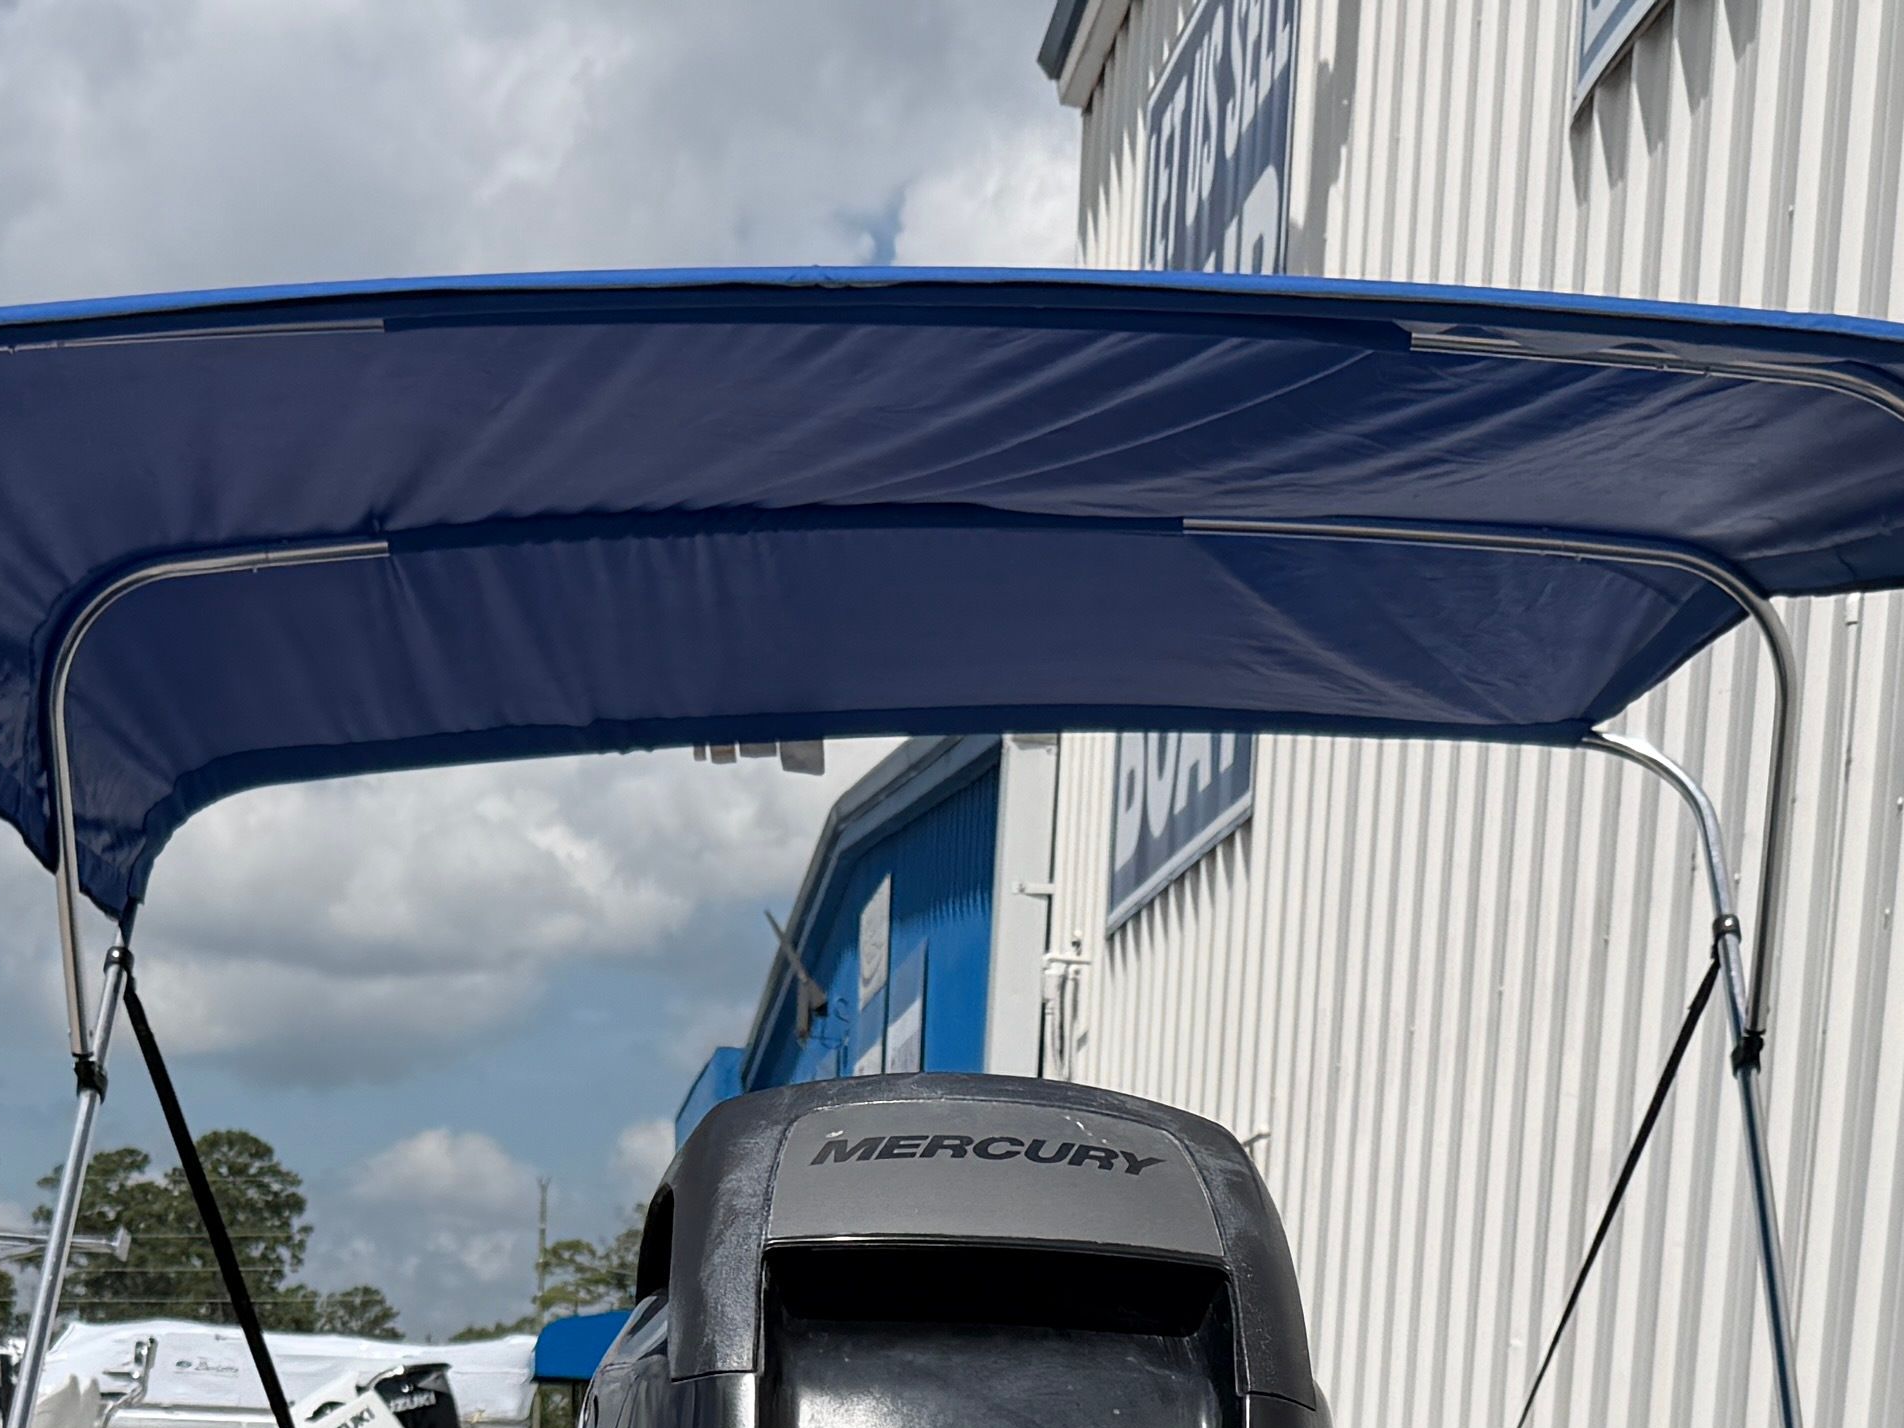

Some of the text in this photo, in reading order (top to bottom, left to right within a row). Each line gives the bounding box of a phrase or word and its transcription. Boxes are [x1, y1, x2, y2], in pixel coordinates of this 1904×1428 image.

[1145, 74, 1188, 271] LET
[1185, 4, 1225, 228] US
[809, 1134, 1168, 1176] MERCURY
